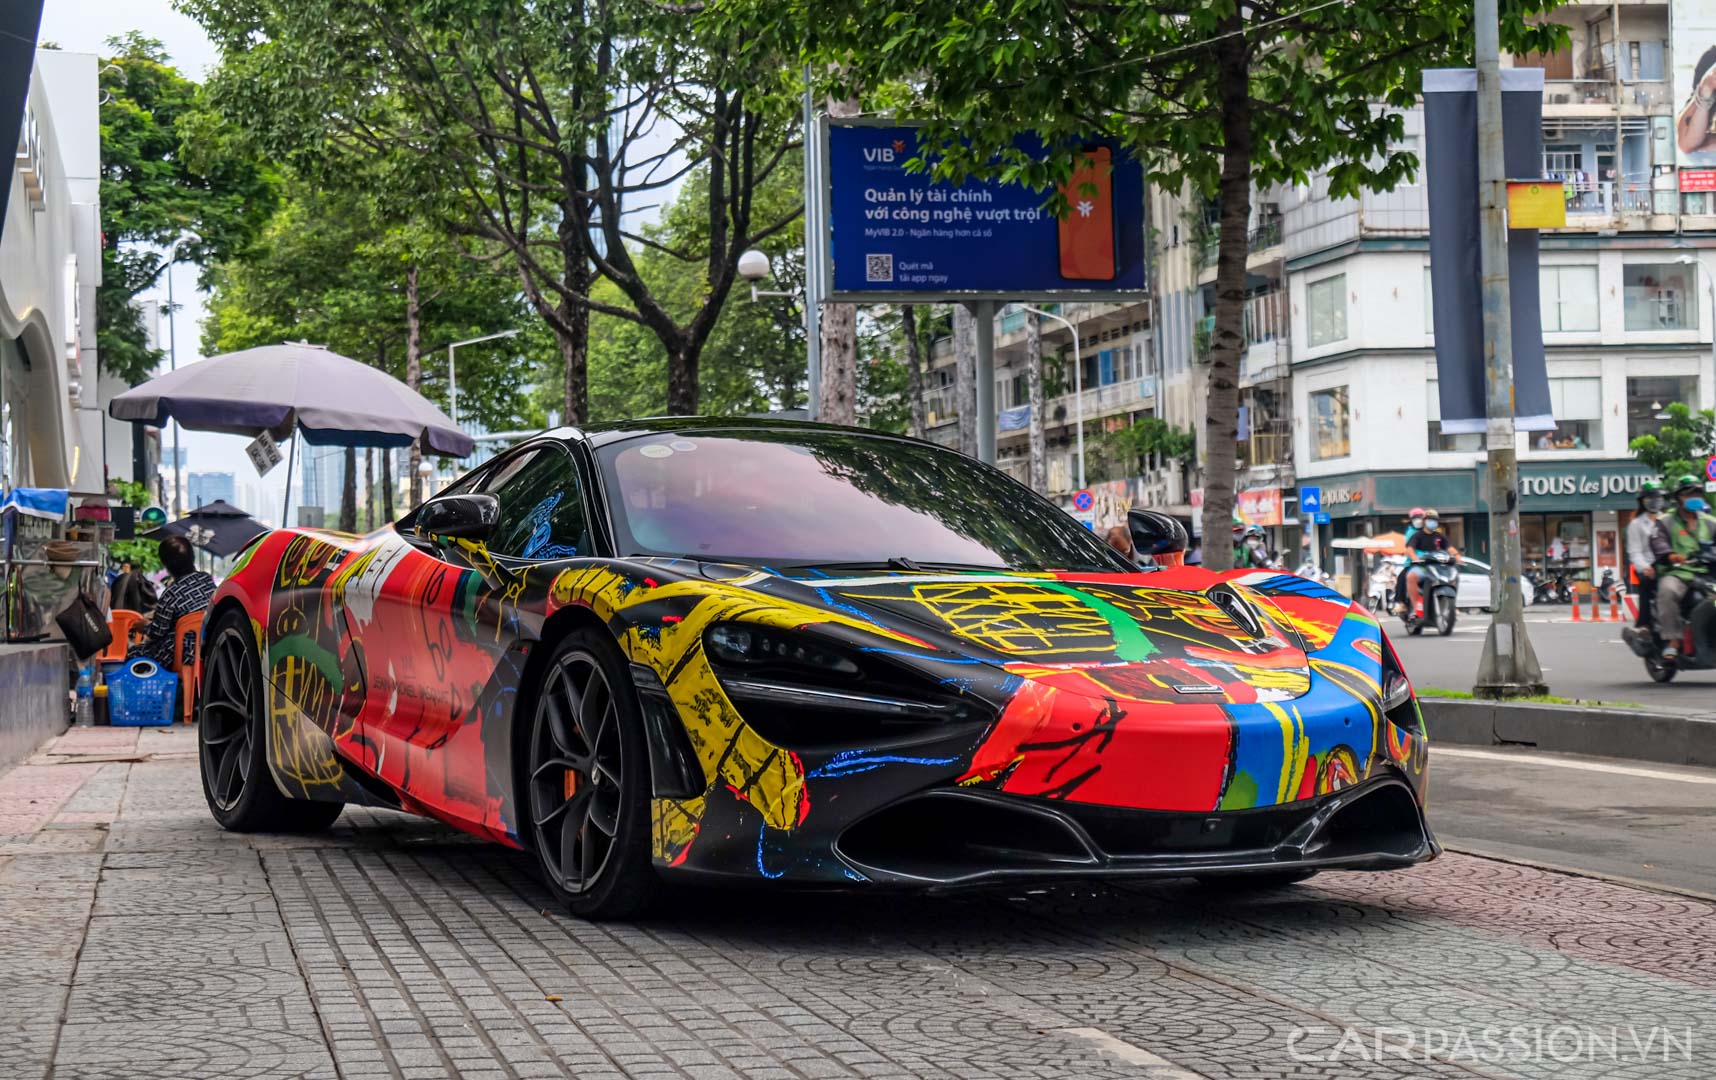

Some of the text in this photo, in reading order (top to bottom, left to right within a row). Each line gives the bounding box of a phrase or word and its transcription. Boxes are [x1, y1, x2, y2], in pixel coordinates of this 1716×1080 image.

[863, 147, 895, 162] VIB
[864, 188, 993, 205] Quản lý tài chính
[865, 206, 1041, 224] với công nghệ vượt trội
[864, 228, 890, 239] MyVIB
[891, 228, 904, 237] 2.0
[933, 228, 954, 239] hàng
[911, 275, 928, 284] app
[928, 275, 949, 284] ngay
[1521, 475, 1576, 496] TOUS
[1579, 474, 1600, 494] les
